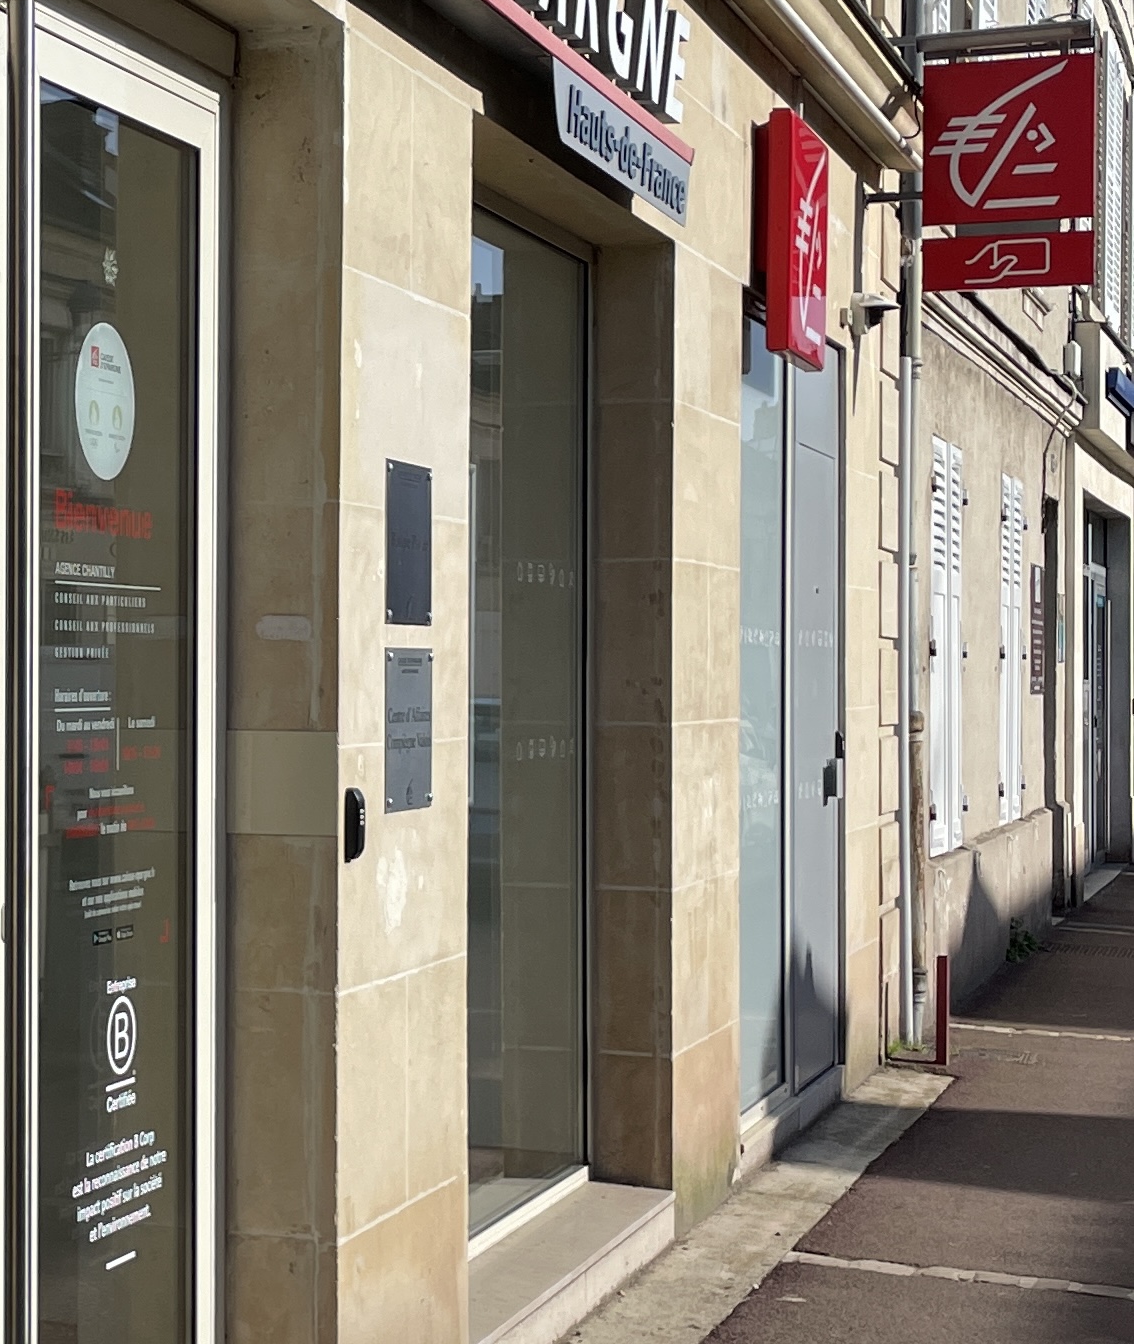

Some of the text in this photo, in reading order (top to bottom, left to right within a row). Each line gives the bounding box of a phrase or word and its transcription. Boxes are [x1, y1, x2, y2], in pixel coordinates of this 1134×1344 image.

[566, 83, 687, 215] Hauts-de-France
[55, 487, 153, 540] Bienvenue
[54, 561, 116, 579] AGENCE CHANTILLY
[54, 591, 146, 608] CONSEIL AUX PARTICULIERS
[54, 619, 155, 634] CONSEIL AUX PROFESSIONNELS
[54, 646, 84, 659] GESTION
[56, 718, 66, 732] Du
[66, 717, 83, 732] mardi
[91, 716, 115, 730] vendredi
[106, 976, 137, 994] Entreprise
[114, 1011, 129, 1060] B
[106, 1089, 137, 1113] Certifiée
[85, 1151, 95, 1168] La
[95, 1138, 133, 1164] certification
[139, 1130, 156, 1147] Corp
[71, 1149, 168, 1199] est la reconnaissance de notre
[76, 1172, 163, 1223] impact positif sur la société
[89, 1227, 98, 1242] et
